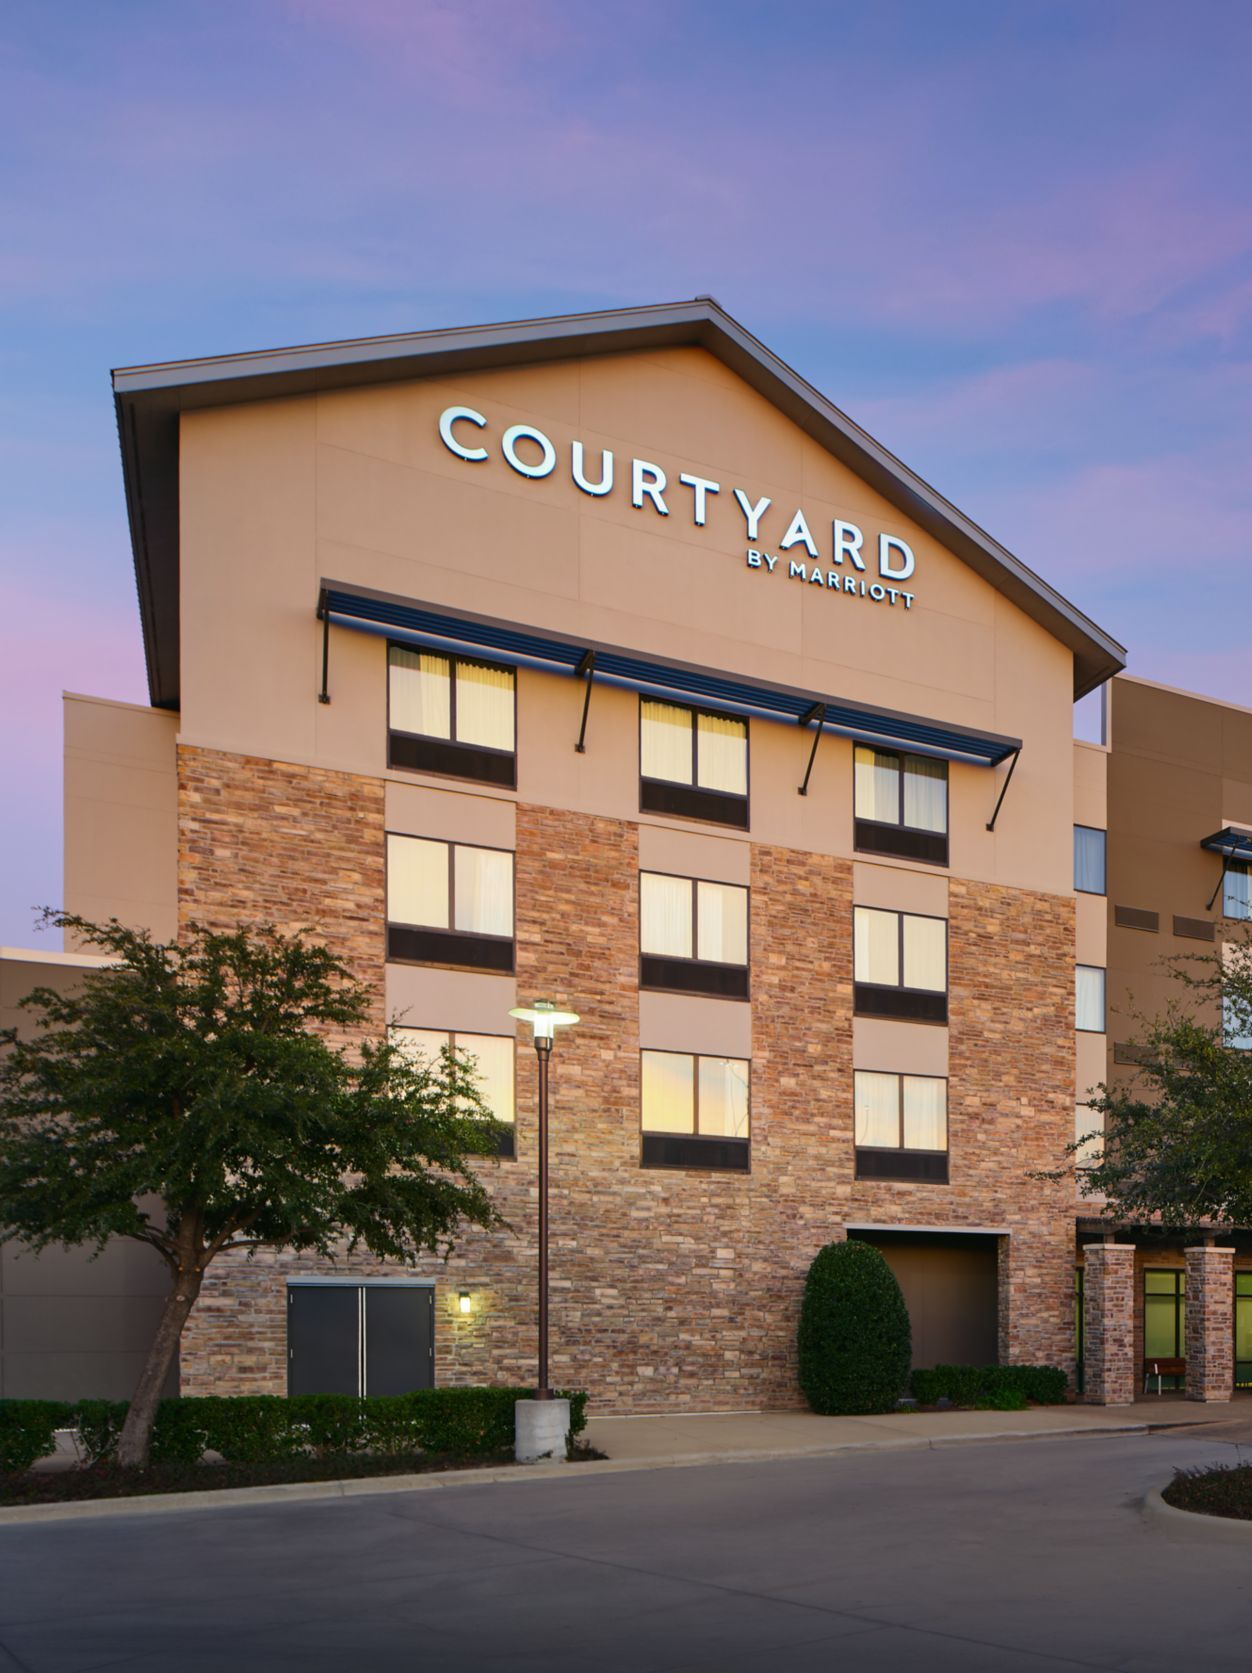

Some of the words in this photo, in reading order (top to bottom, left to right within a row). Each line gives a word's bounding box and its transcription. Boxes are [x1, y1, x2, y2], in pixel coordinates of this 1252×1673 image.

[438, 406, 916, 581] COURTYARD
[747, 549, 779, 571] BY
[789, 561, 915, 609] MARRIOTT
